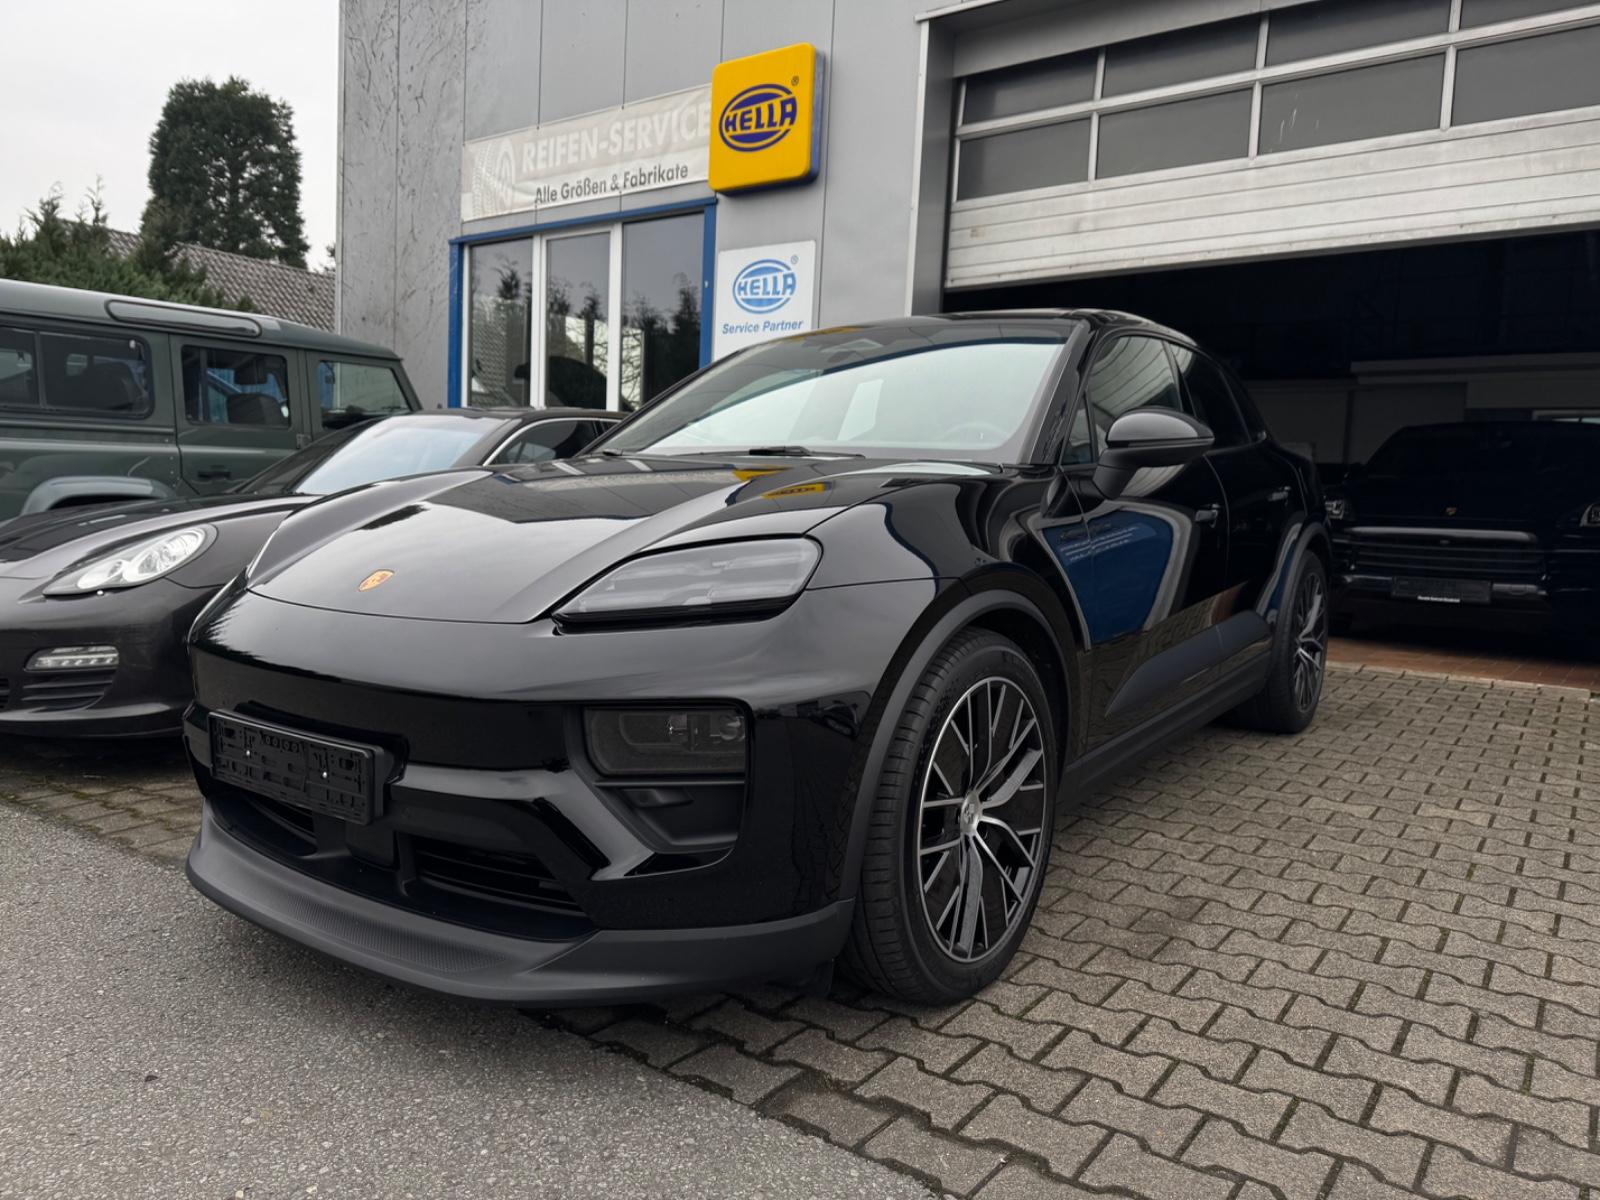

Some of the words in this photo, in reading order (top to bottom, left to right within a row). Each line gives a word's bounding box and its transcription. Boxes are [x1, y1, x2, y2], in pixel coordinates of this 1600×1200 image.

[724, 96, 798, 133] HELLA
[521, 101, 711, 174] REIFEN-SERVICE
[535, 186, 558, 204] Alle
[560, 177, 607, 199] Größen
[610, 174, 620, 191] &
[623, 163, 689, 188] Fabrikate
[737, 271, 797, 296] HELLA
[722, 322, 760, 334] Service
[762, 320, 804, 332] Partner
